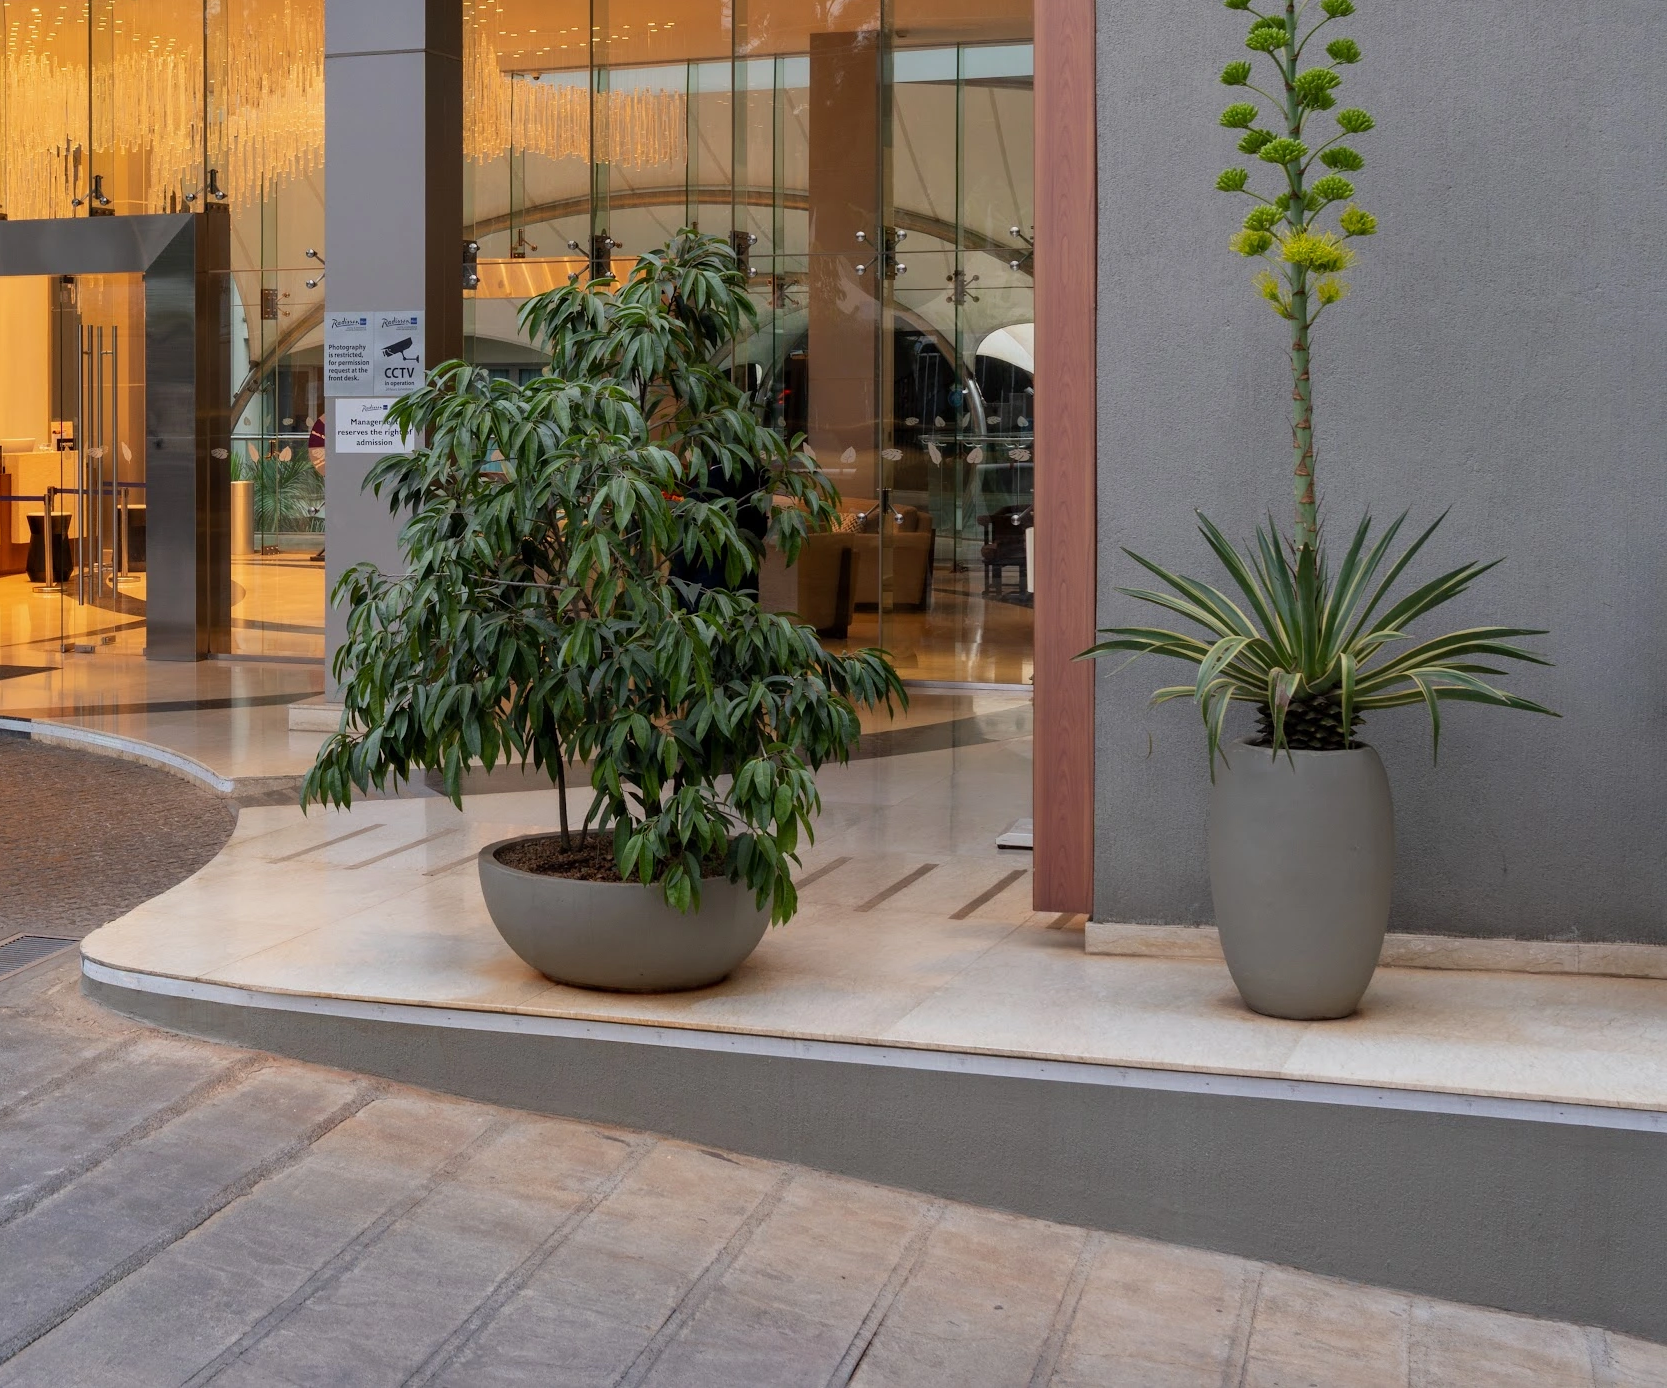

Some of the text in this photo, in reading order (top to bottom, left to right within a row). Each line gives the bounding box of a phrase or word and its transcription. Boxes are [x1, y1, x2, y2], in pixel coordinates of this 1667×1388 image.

[381, 317, 410, 329] Radisson
[384, 367, 415, 379] CCTV
[350, 419, 399, 427] Manageet
